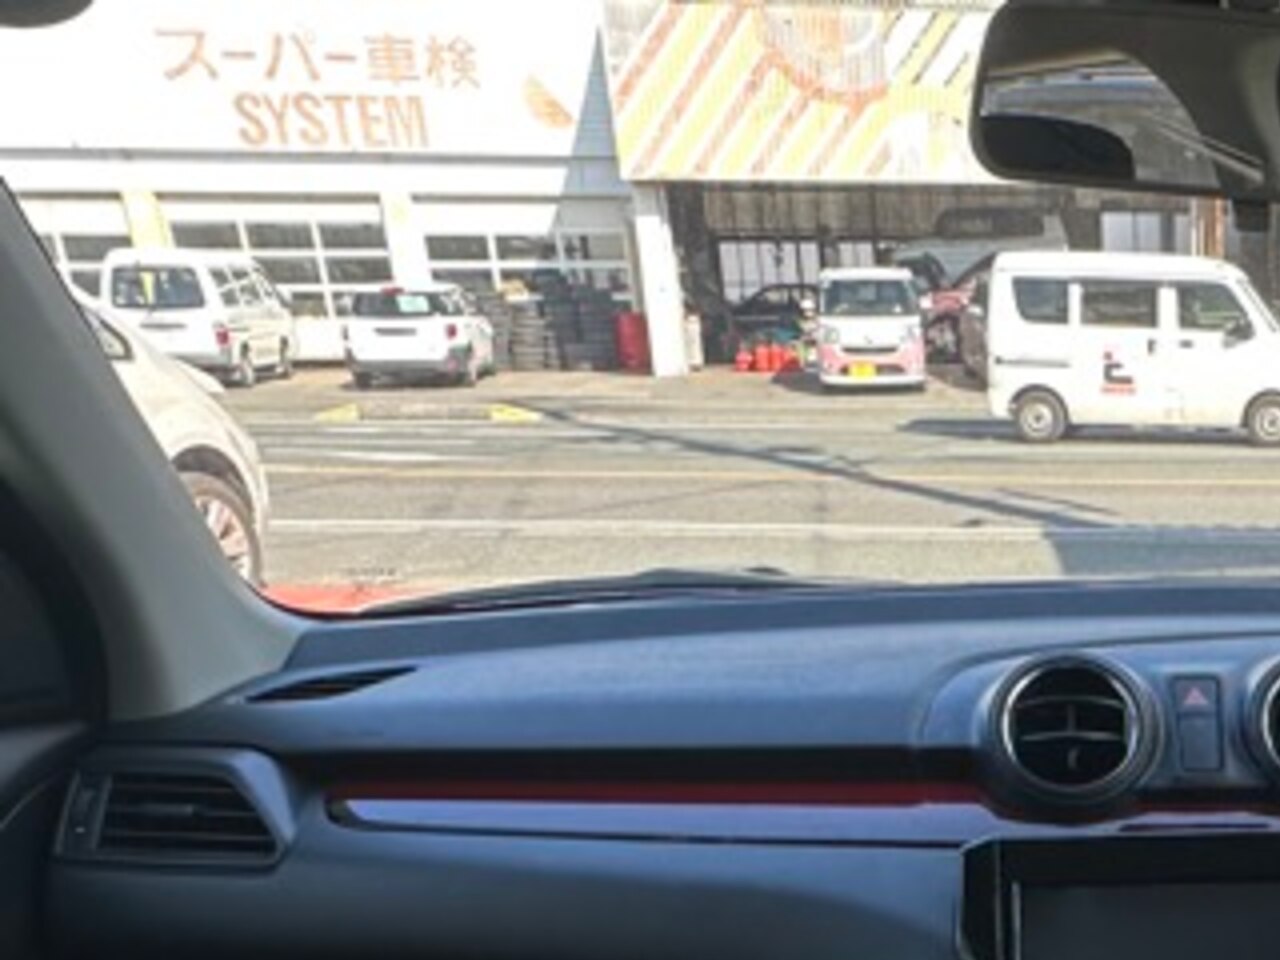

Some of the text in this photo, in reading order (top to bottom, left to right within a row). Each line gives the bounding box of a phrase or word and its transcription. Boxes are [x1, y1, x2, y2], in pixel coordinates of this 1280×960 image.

[154, 28, 481, 88] スーパー車検
[233, 91, 429, 148] SYSTEM
